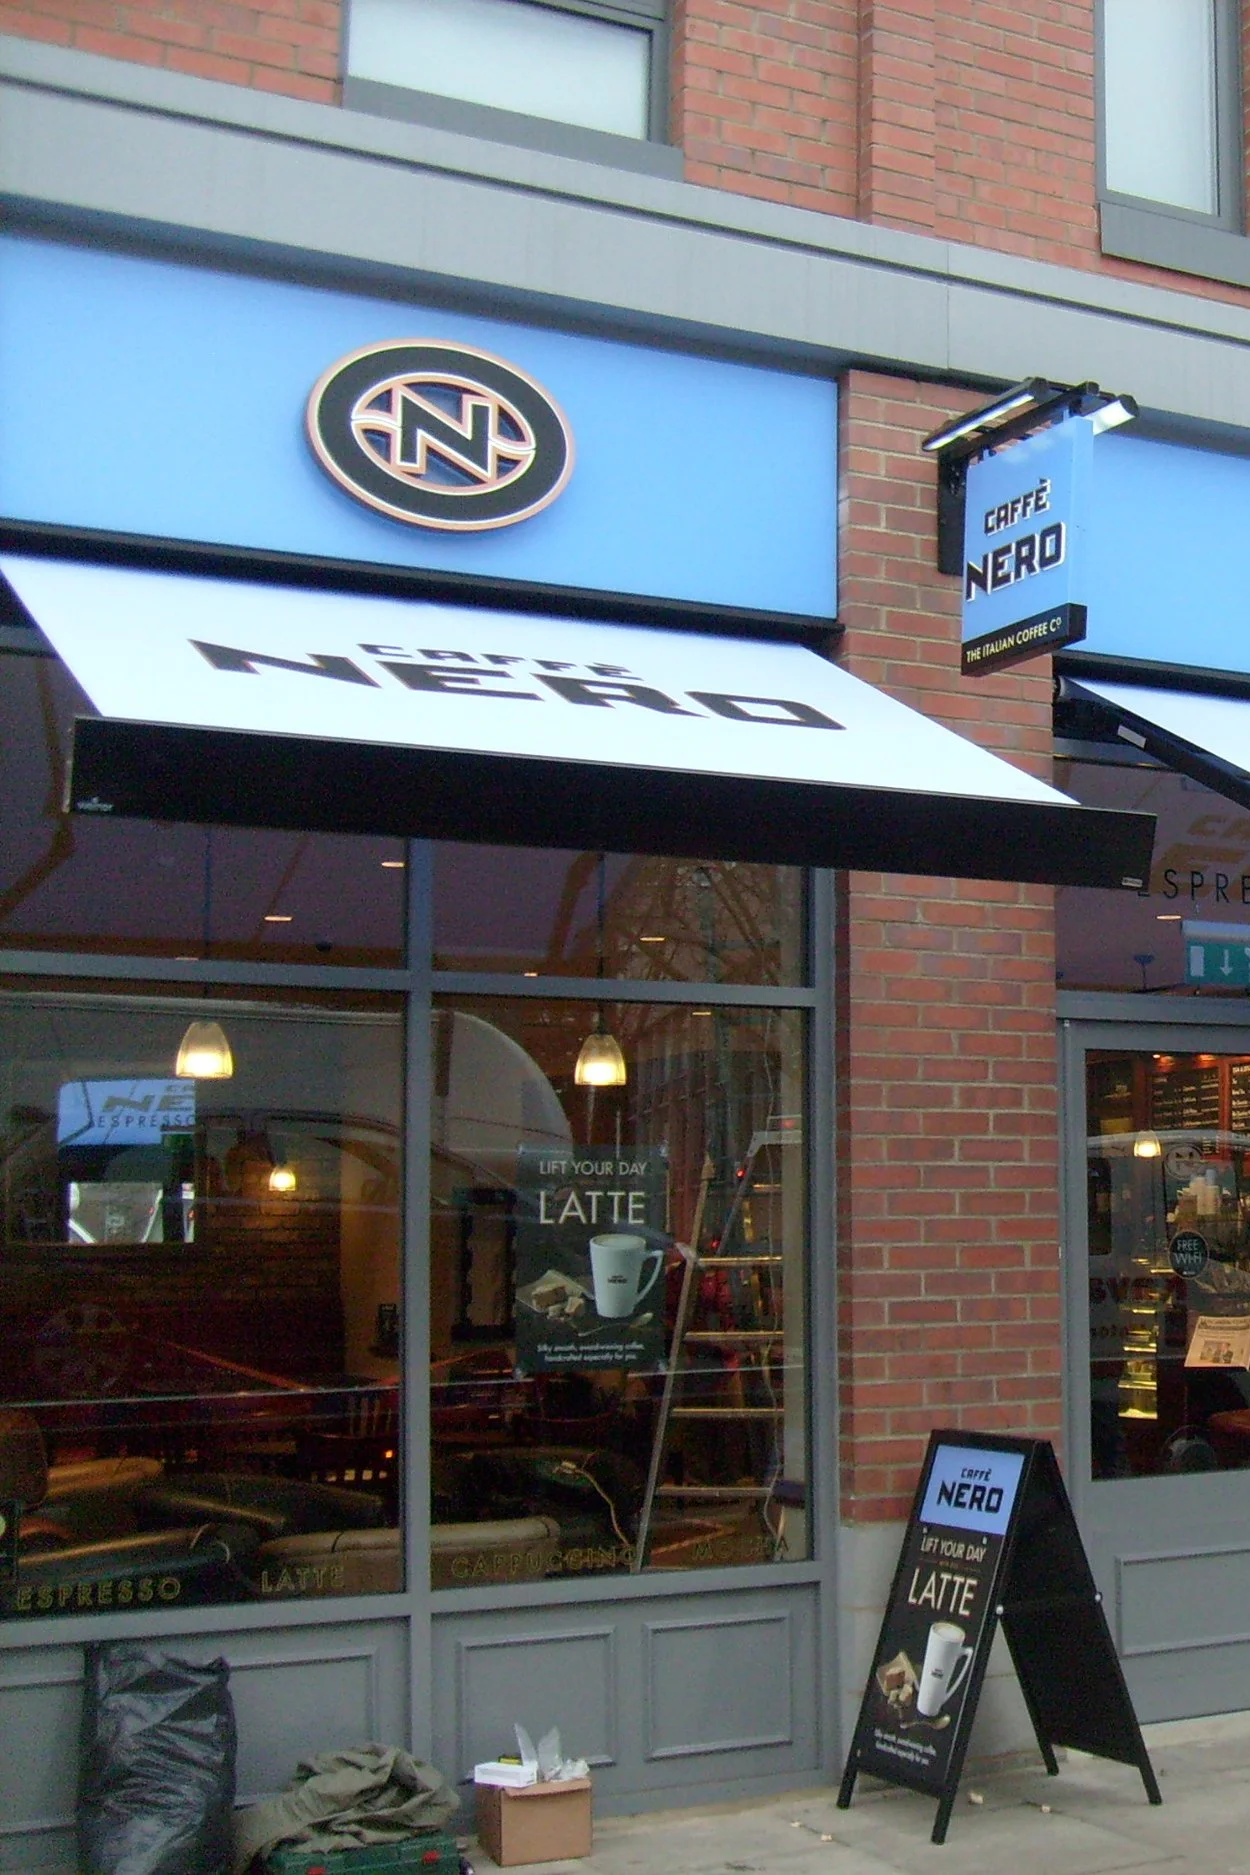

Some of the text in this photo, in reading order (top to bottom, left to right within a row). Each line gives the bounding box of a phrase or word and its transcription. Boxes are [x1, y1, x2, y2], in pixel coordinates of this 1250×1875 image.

[984, 477, 1052, 536] CAFFÈ
[965, 521, 1066, 602] NERO
[966, 647, 981, 663] THE
[982, 635, 1015, 657] ITALIAN
[1016, 622, 1048, 644] COFFEE
[186, 639, 848, 730] NERO
[539, 1161, 648, 1175] LIFT YOUR DAY
[539, 1191, 646, 1224] LATTE
[1176, 1240, 1200, 1251] FREE
[936, 1480, 1004, 1514] NERO
[921, 1535, 987, 1562] LIFT YOUR DAY
[15, 1576, 182, 1611] ESPRESSO
[260, 1565, 345, 1593] LATTE
[908, 1568, 978, 1617] LATTE
